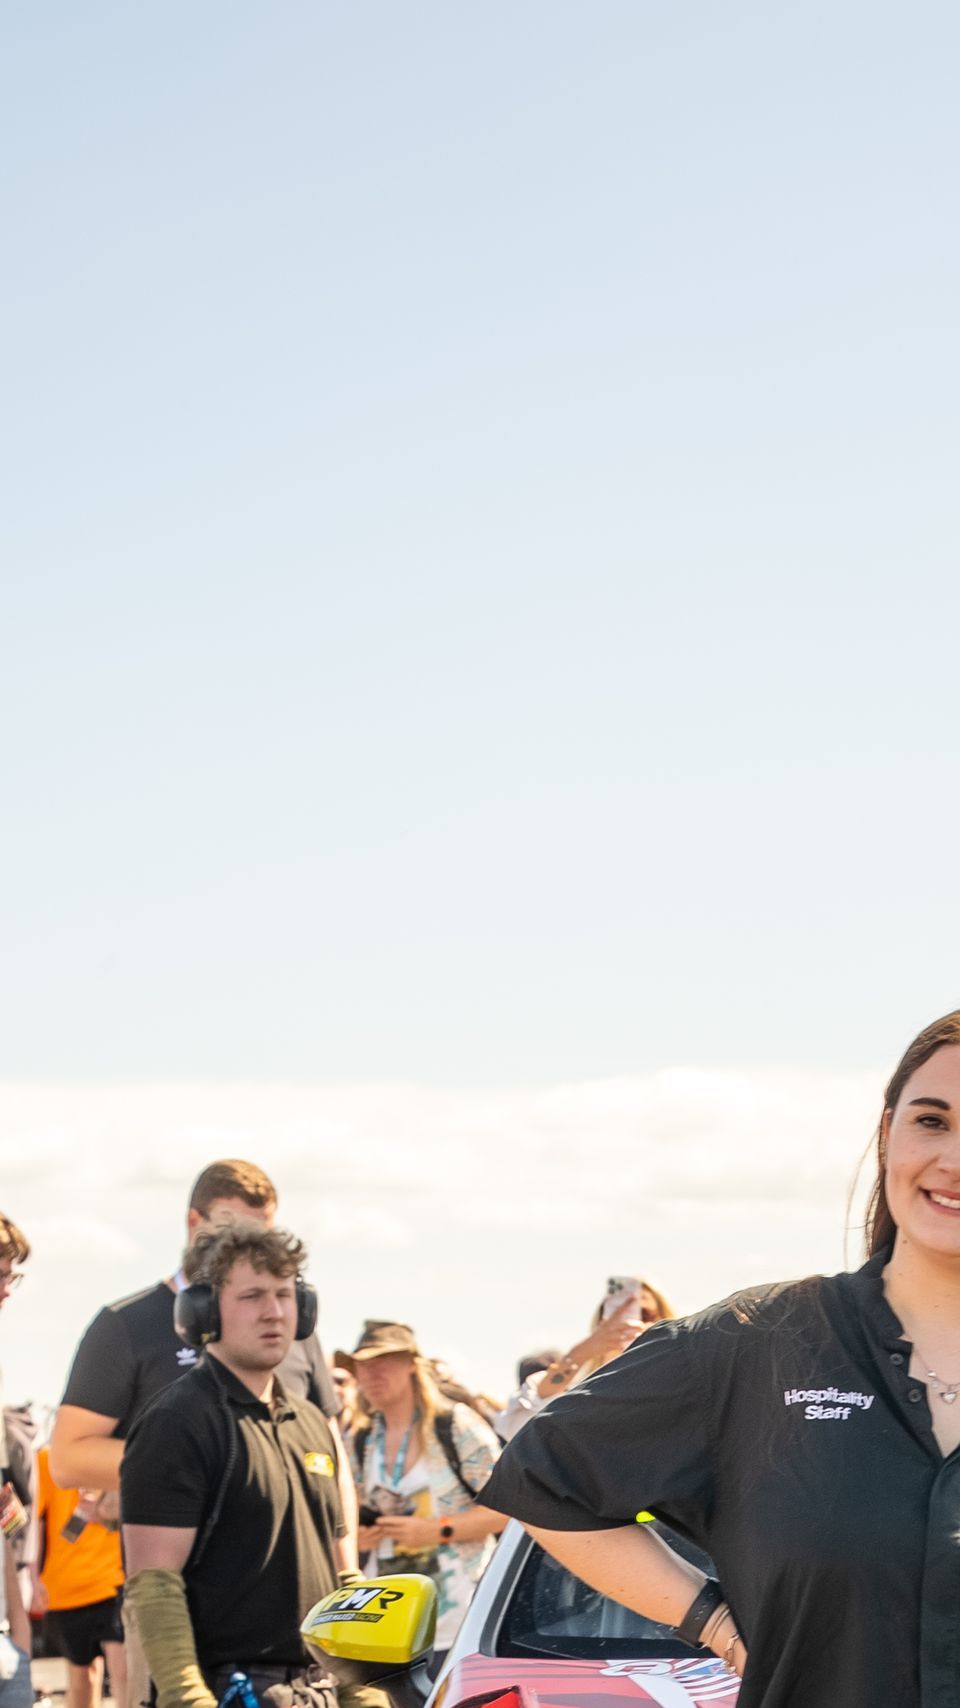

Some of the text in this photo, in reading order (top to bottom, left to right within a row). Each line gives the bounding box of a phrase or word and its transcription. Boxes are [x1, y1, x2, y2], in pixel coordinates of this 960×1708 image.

[784, 1387, 875, 1410] Hospitality
[804, 1405, 852, 1420] Staff
[320, 1588, 404, 1610] PMR
